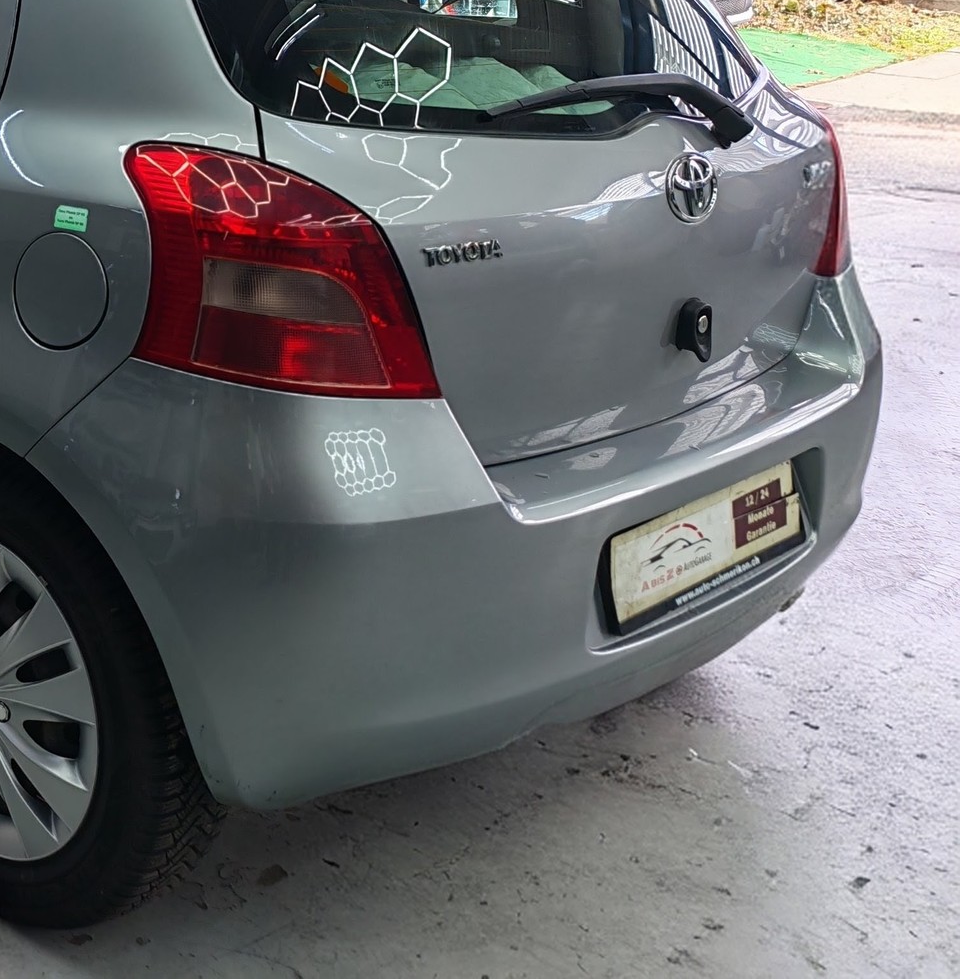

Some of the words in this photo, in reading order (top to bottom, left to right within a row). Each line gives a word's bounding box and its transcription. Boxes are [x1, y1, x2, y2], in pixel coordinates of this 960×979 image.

[422, 239, 504, 267] TOYOTA
[747, 505, 774, 524] Monate
[746, 520, 777, 541] Garantie
[675, 555, 760, 606] www.auto-schmerikon.ch
